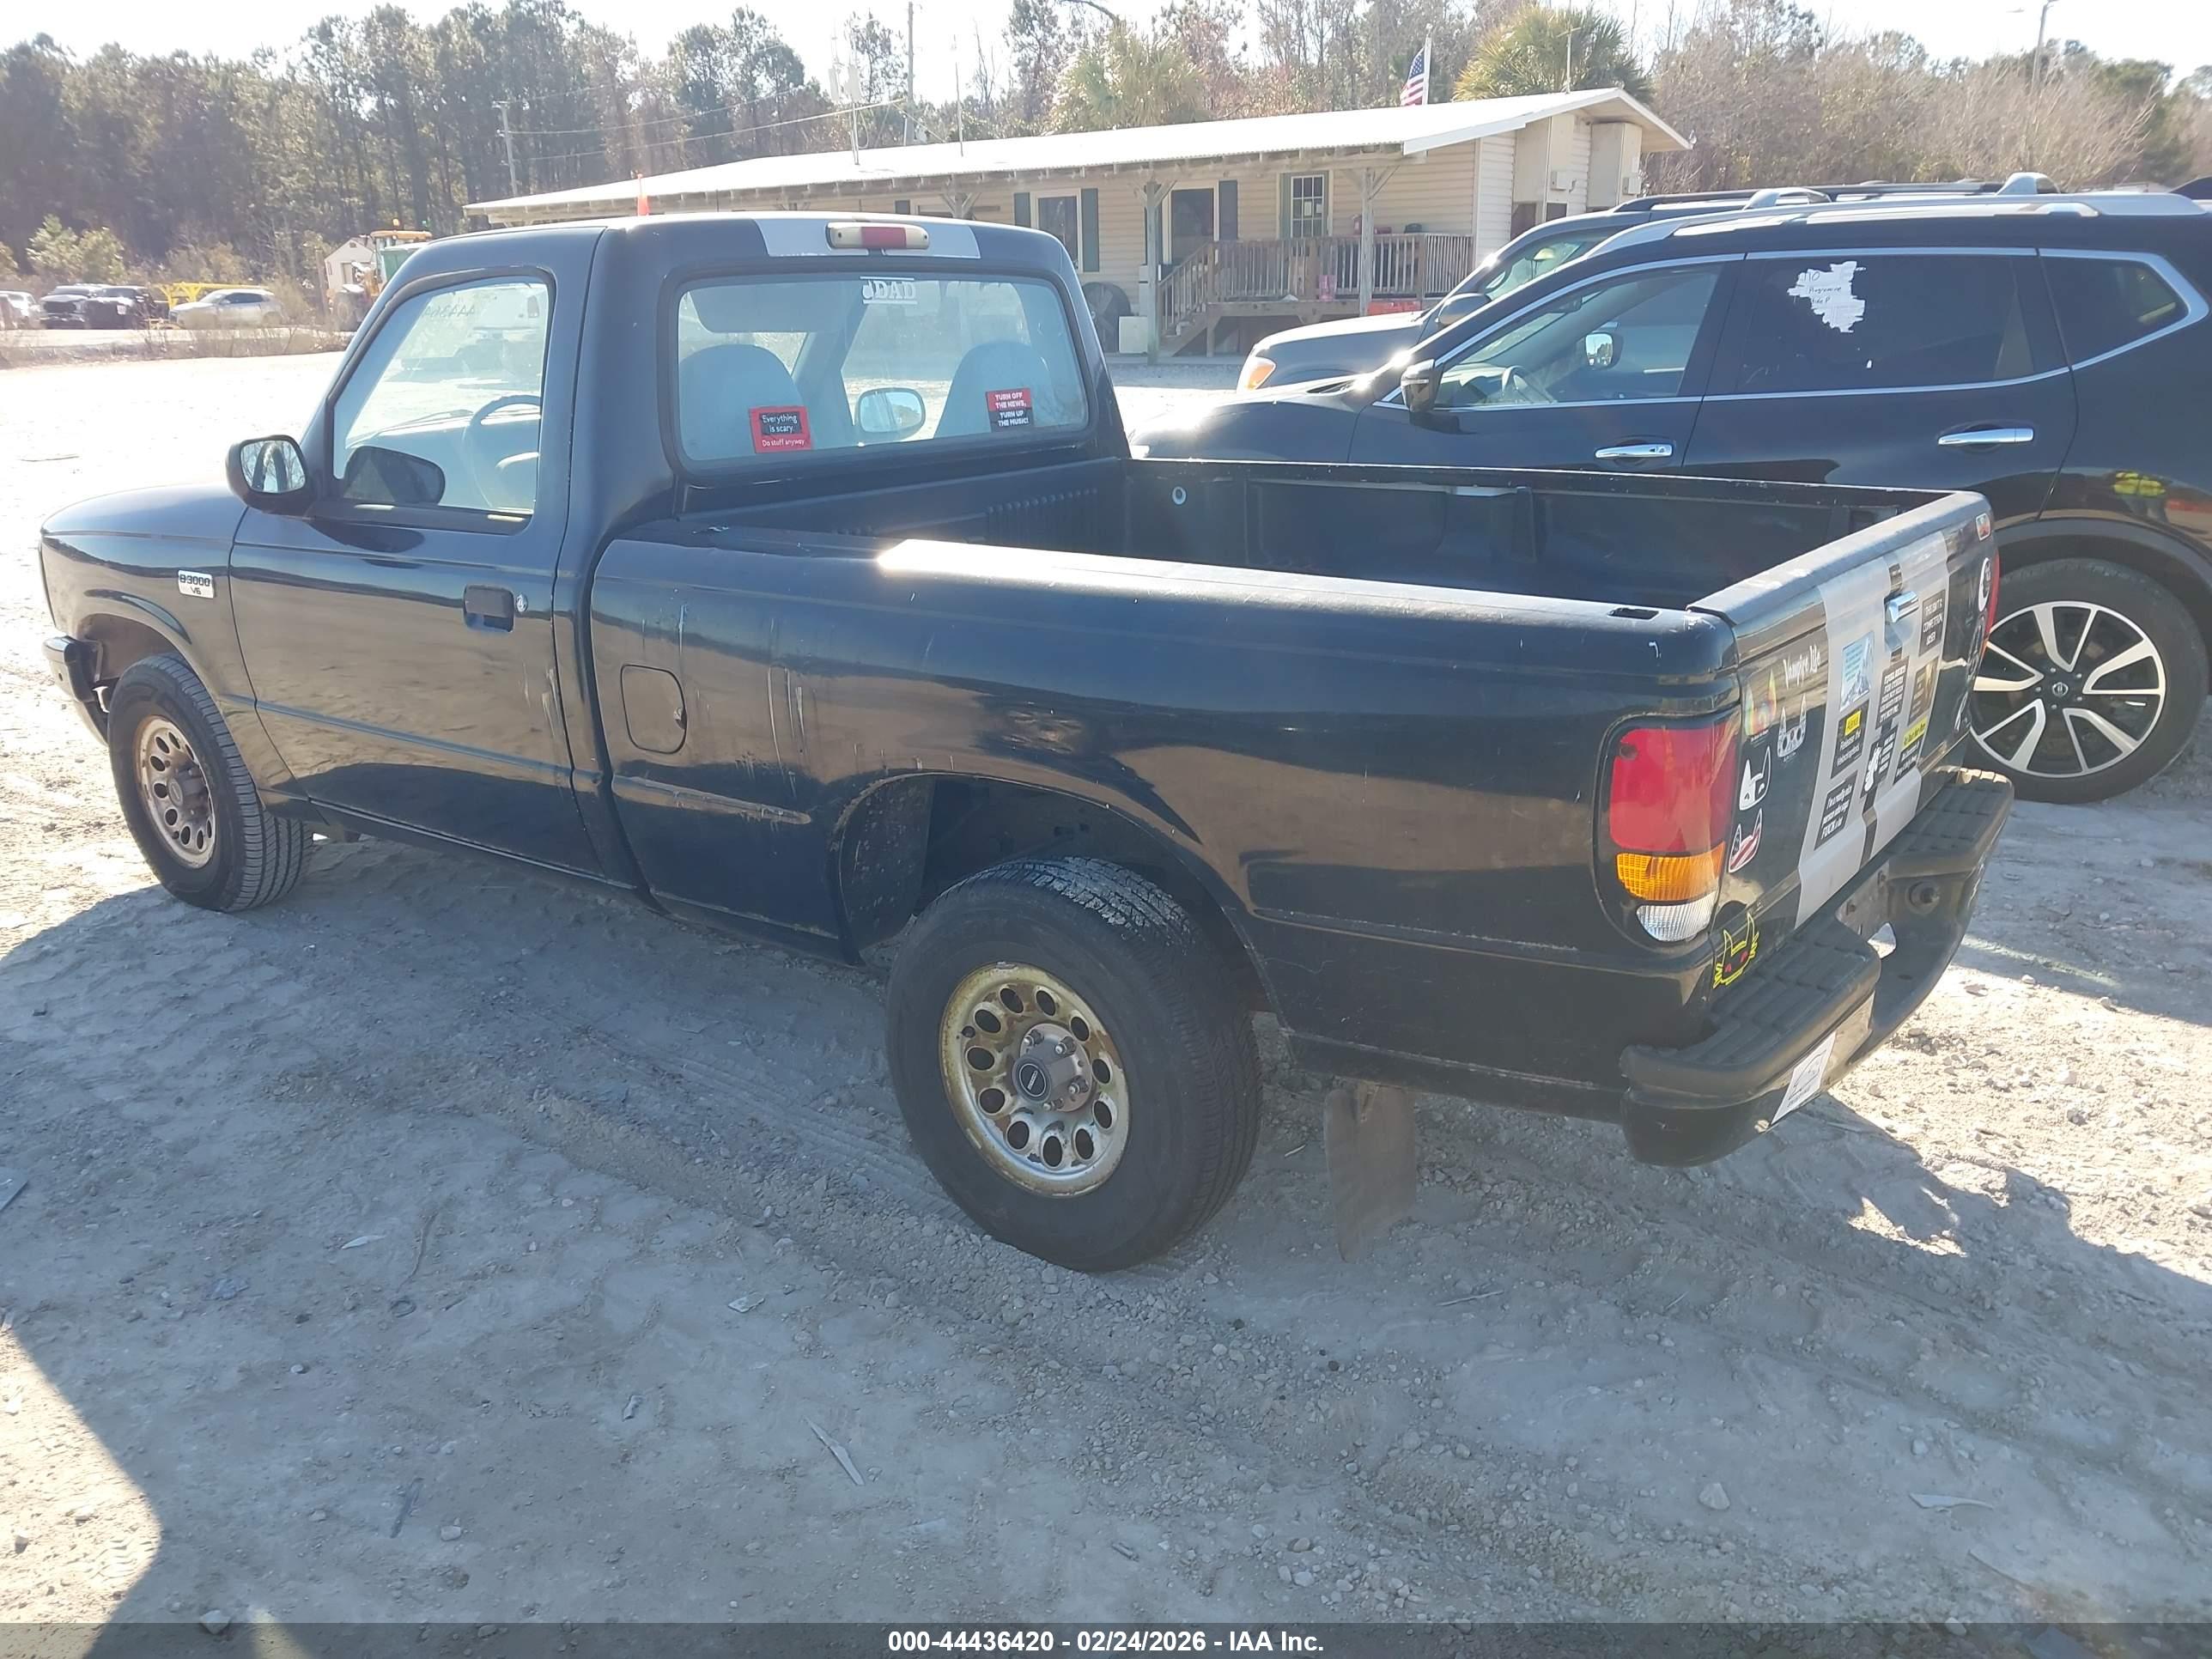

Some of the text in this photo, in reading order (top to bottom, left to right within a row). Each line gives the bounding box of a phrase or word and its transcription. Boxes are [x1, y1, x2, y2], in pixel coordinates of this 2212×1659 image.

[762, 413, 798, 424] Everything
[1000, 410, 1015, 419] TURN
[179, 574, 211, 586] B3000
[190, 586, 202, 595] V6
[1840, 732, 1855, 750] Release
